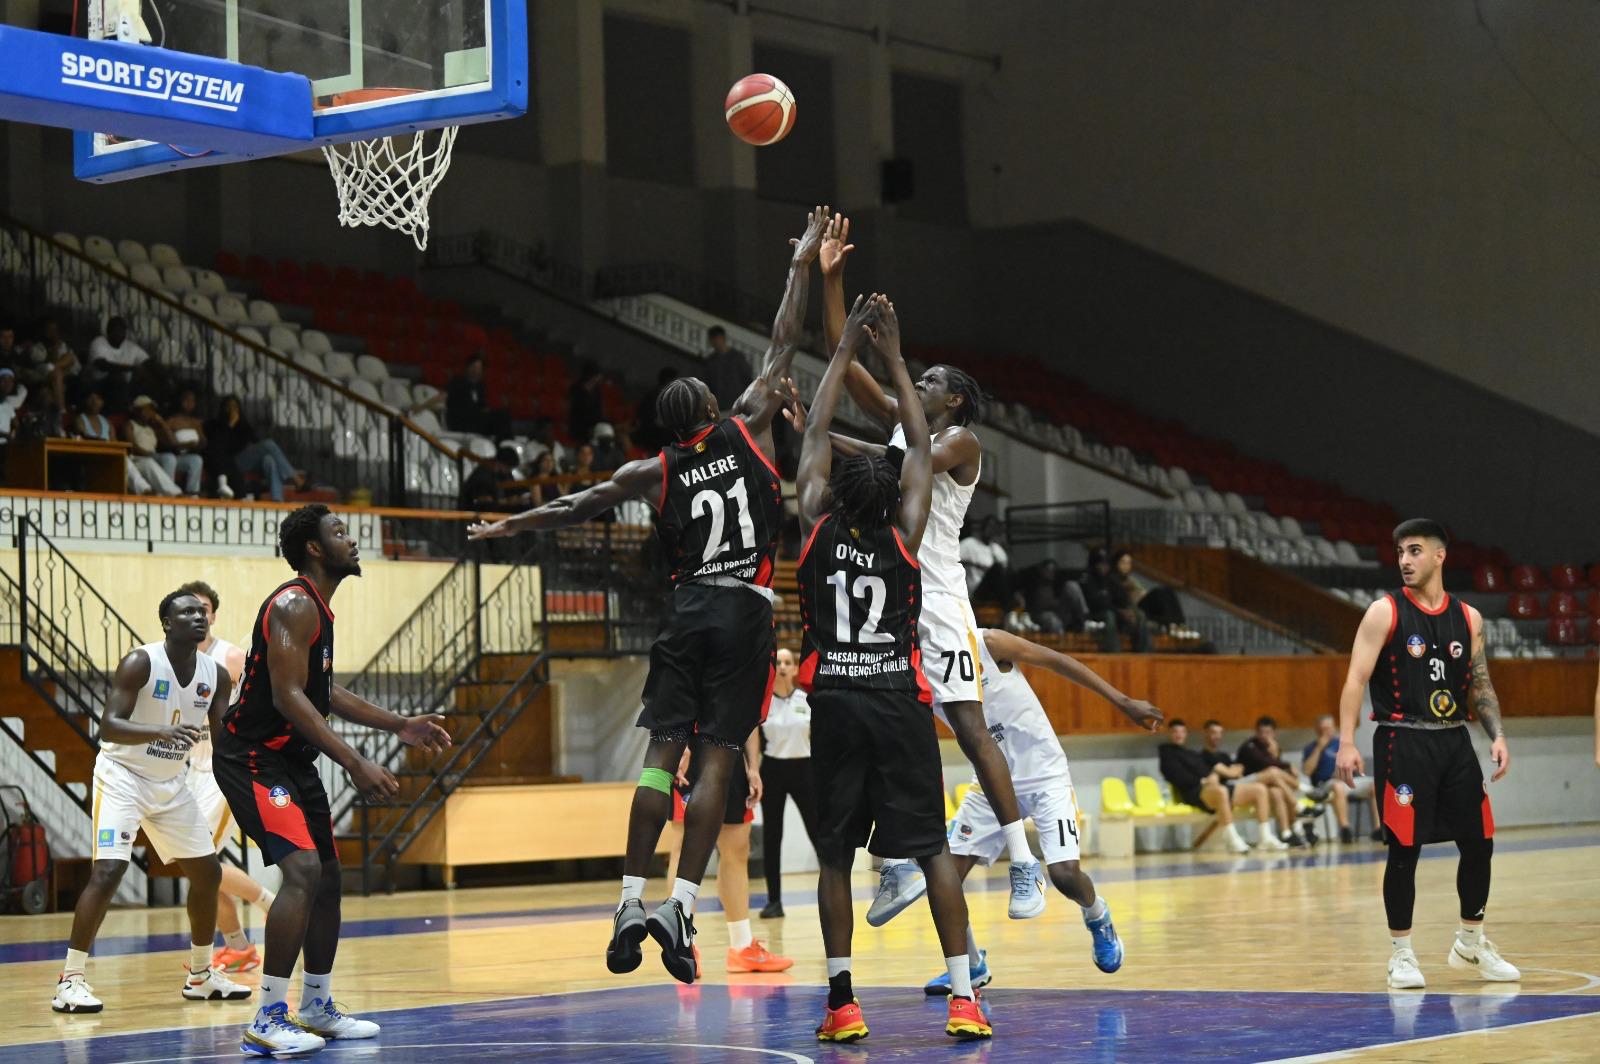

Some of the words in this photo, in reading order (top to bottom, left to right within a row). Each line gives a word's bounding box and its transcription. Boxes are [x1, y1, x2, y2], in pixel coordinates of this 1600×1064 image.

[61, 52, 145, 87] SPORT
[146, 67, 245, 104] SYSTEM
[679, 454, 738, 487] VALERE
[691, 477, 756, 564] 21
[835, 543, 874, 568] OVEY
[826, 570, 896, 644] 12
[827, 651, 858, 664] CAESAR
[940, 650, 975, 684] 70
[1057, 818, 1079, 847] 14
